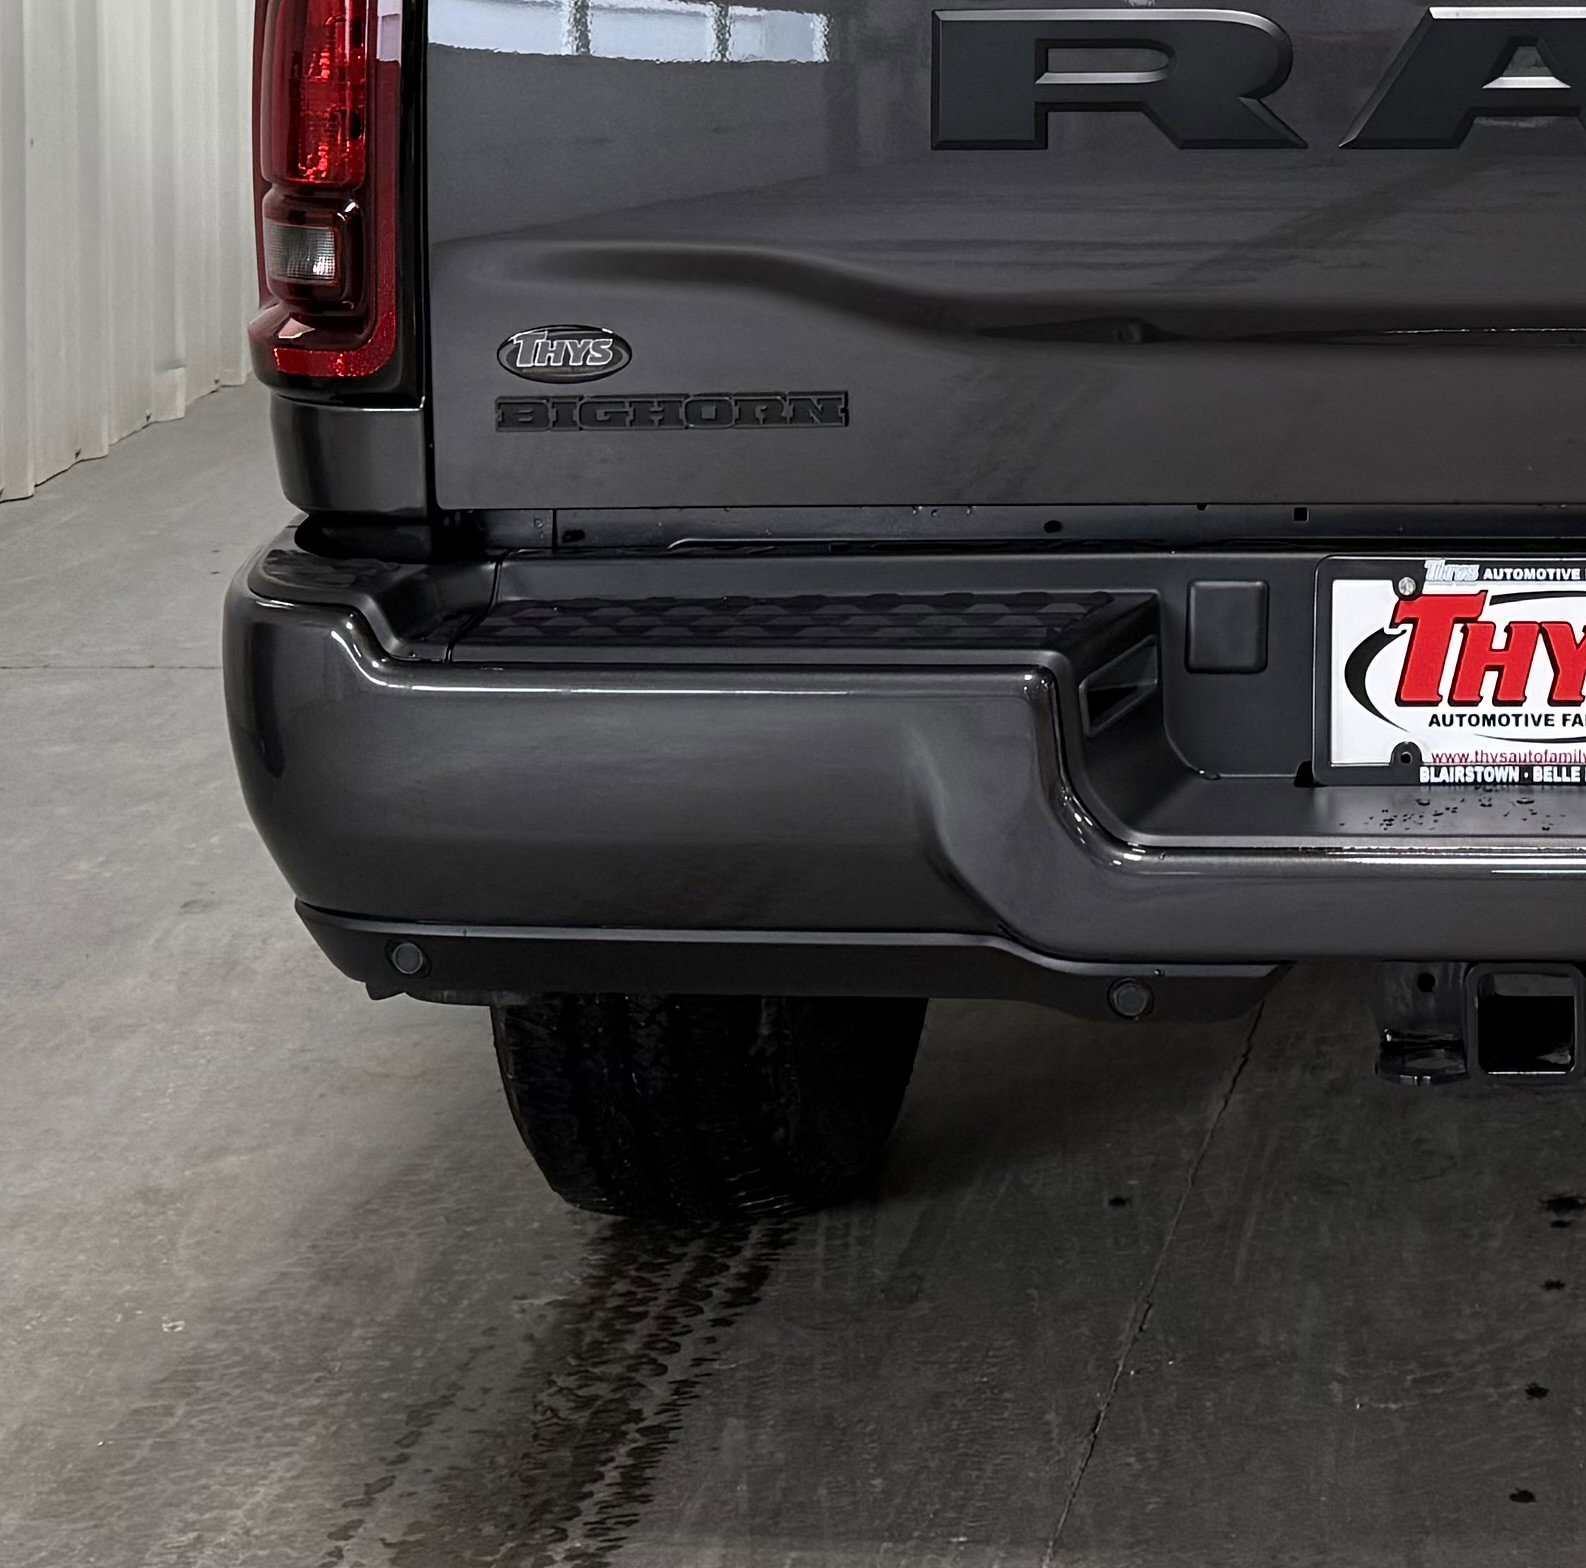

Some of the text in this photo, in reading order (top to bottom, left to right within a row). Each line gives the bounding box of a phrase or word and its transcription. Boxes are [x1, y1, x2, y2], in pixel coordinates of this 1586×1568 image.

[495, 391, 849, 432] BIGHORN
[1483, 567, 1580, 581] AUTOMOTIVE
[1428, 713, 1555, 728] AUTOMOTIVE
[1419, 765, 1519, 783] BLAIRSTOWN
[1532, 765, 1580, 783] BELLE
